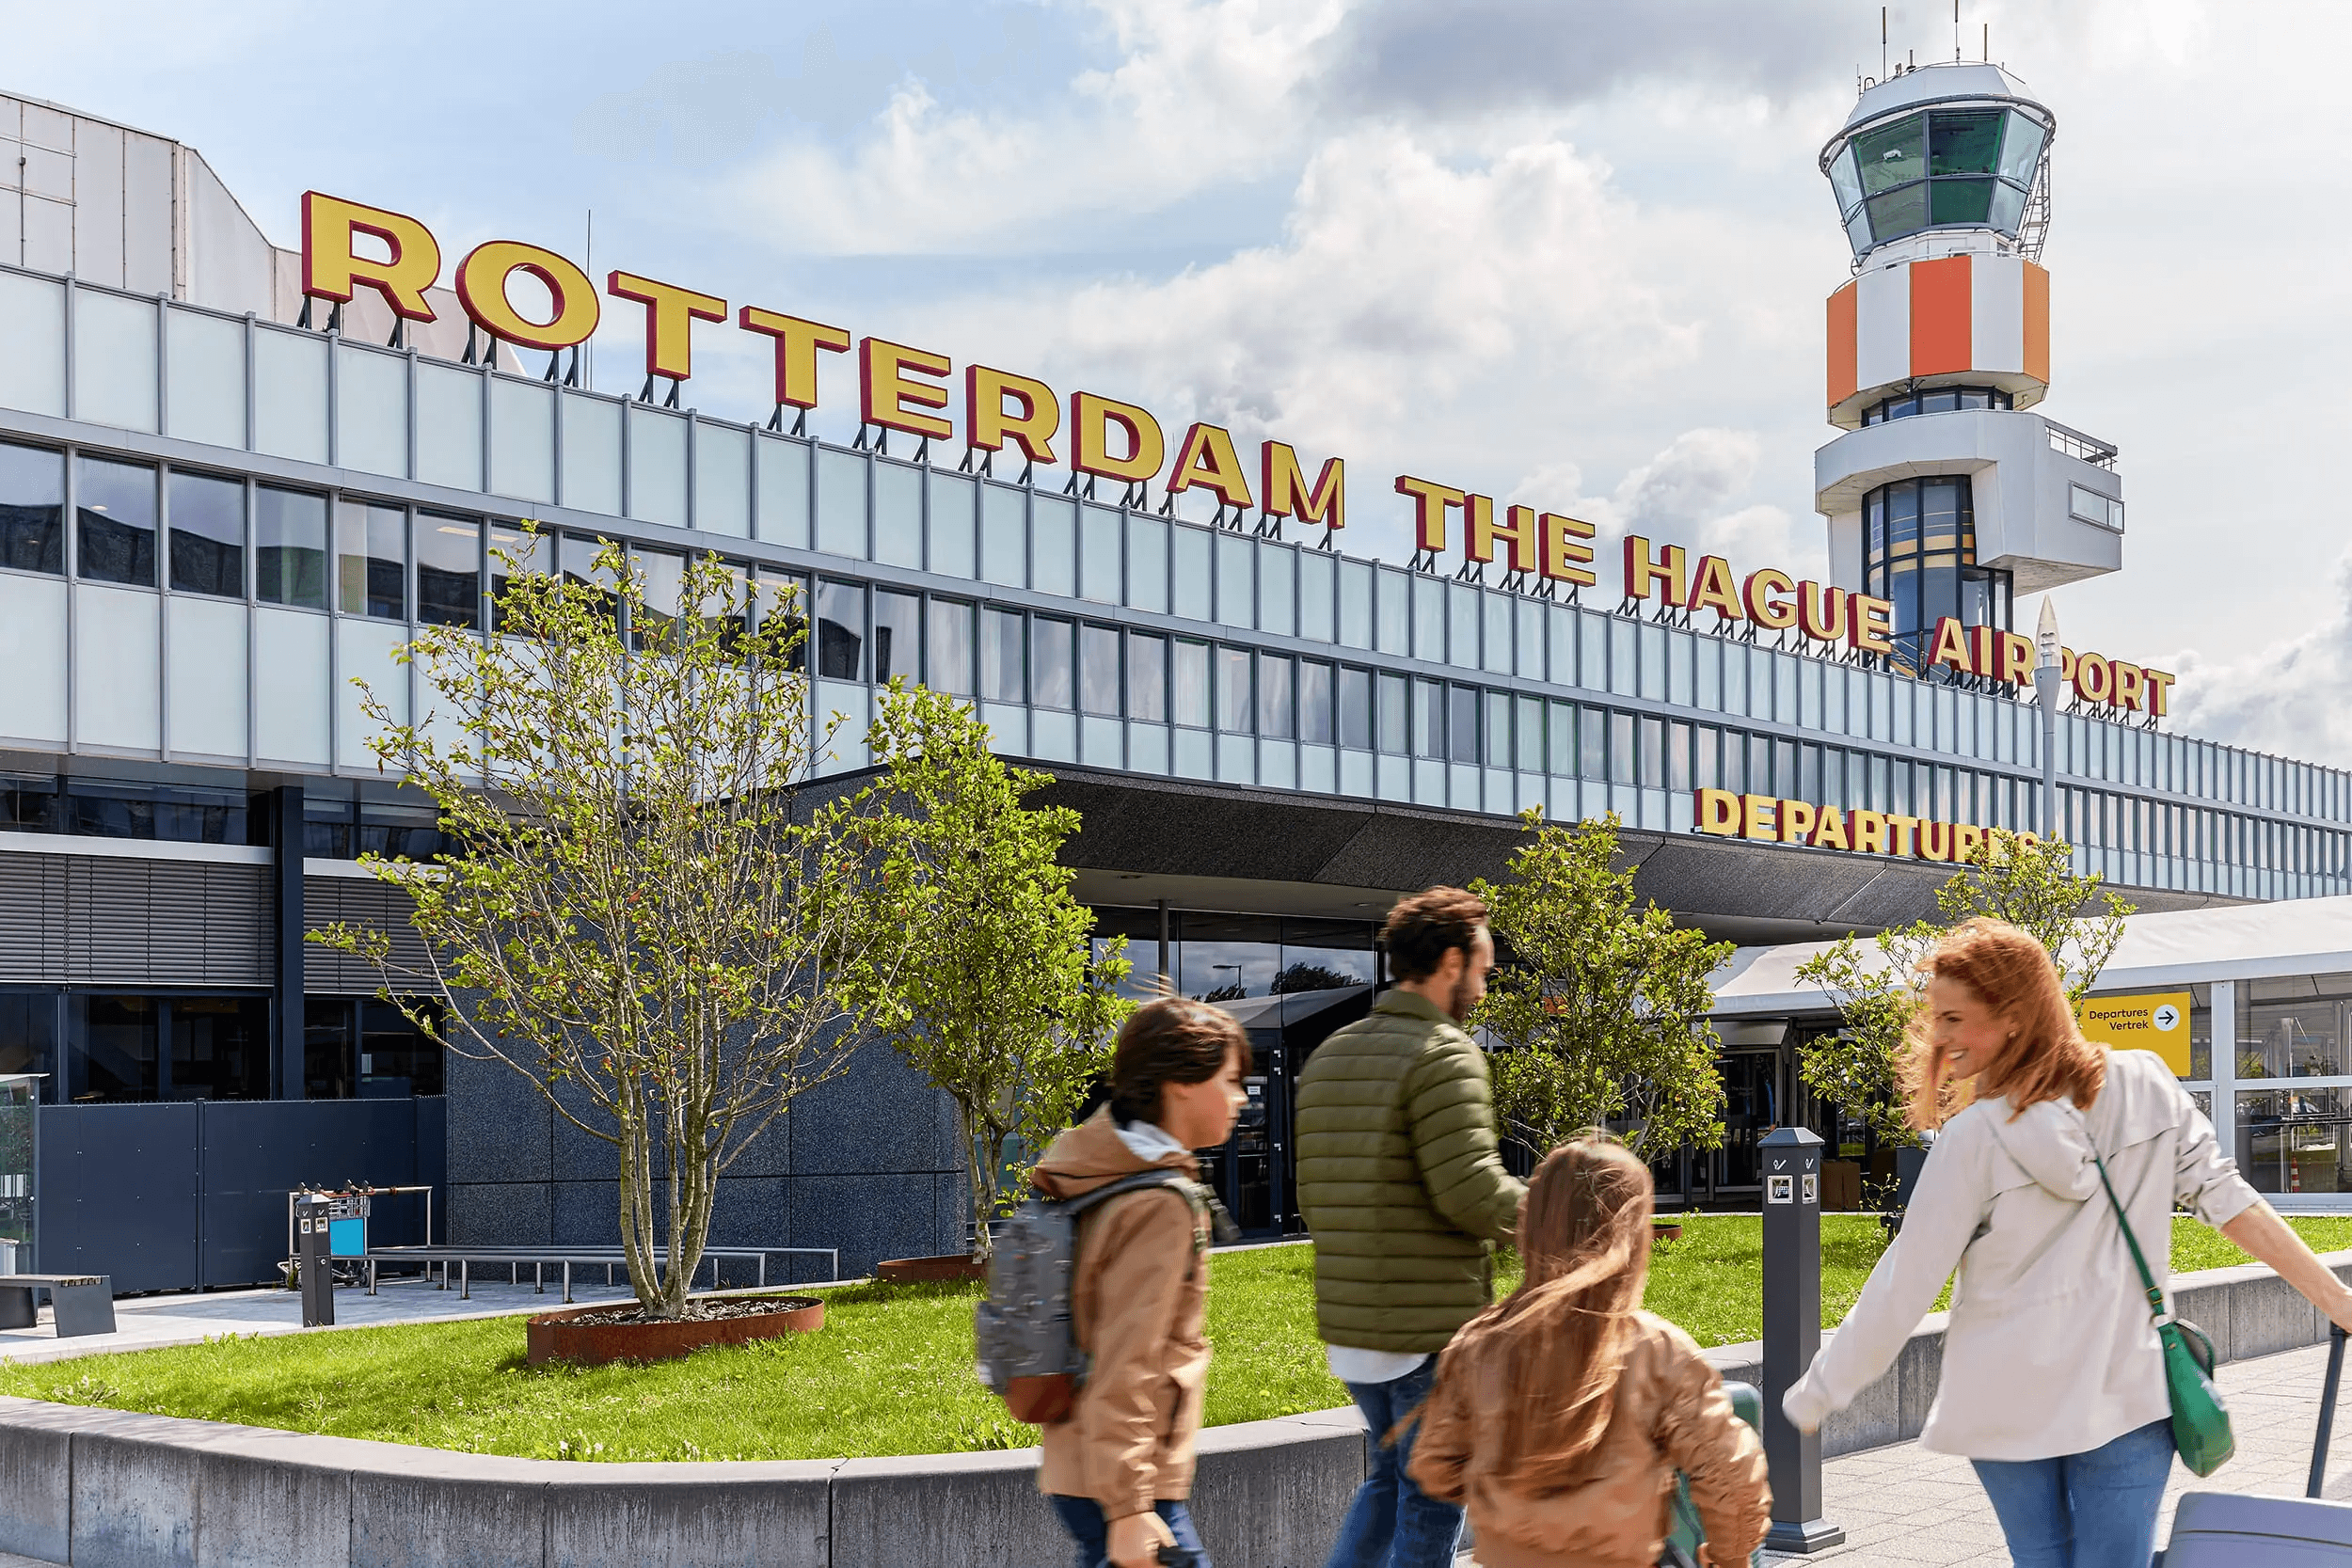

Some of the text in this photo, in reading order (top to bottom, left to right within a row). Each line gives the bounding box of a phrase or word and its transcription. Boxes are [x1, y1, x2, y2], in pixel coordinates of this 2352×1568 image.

[301, 190, 1344, 530] ROTTERDAM
[1395, 475, 1596, 587] THE
[1623, 534, 1892, 655] HAGUE
[2089, 1008, 2149, 1021] Departures
[2109, 1020, 2149, 1030] Vertrek
